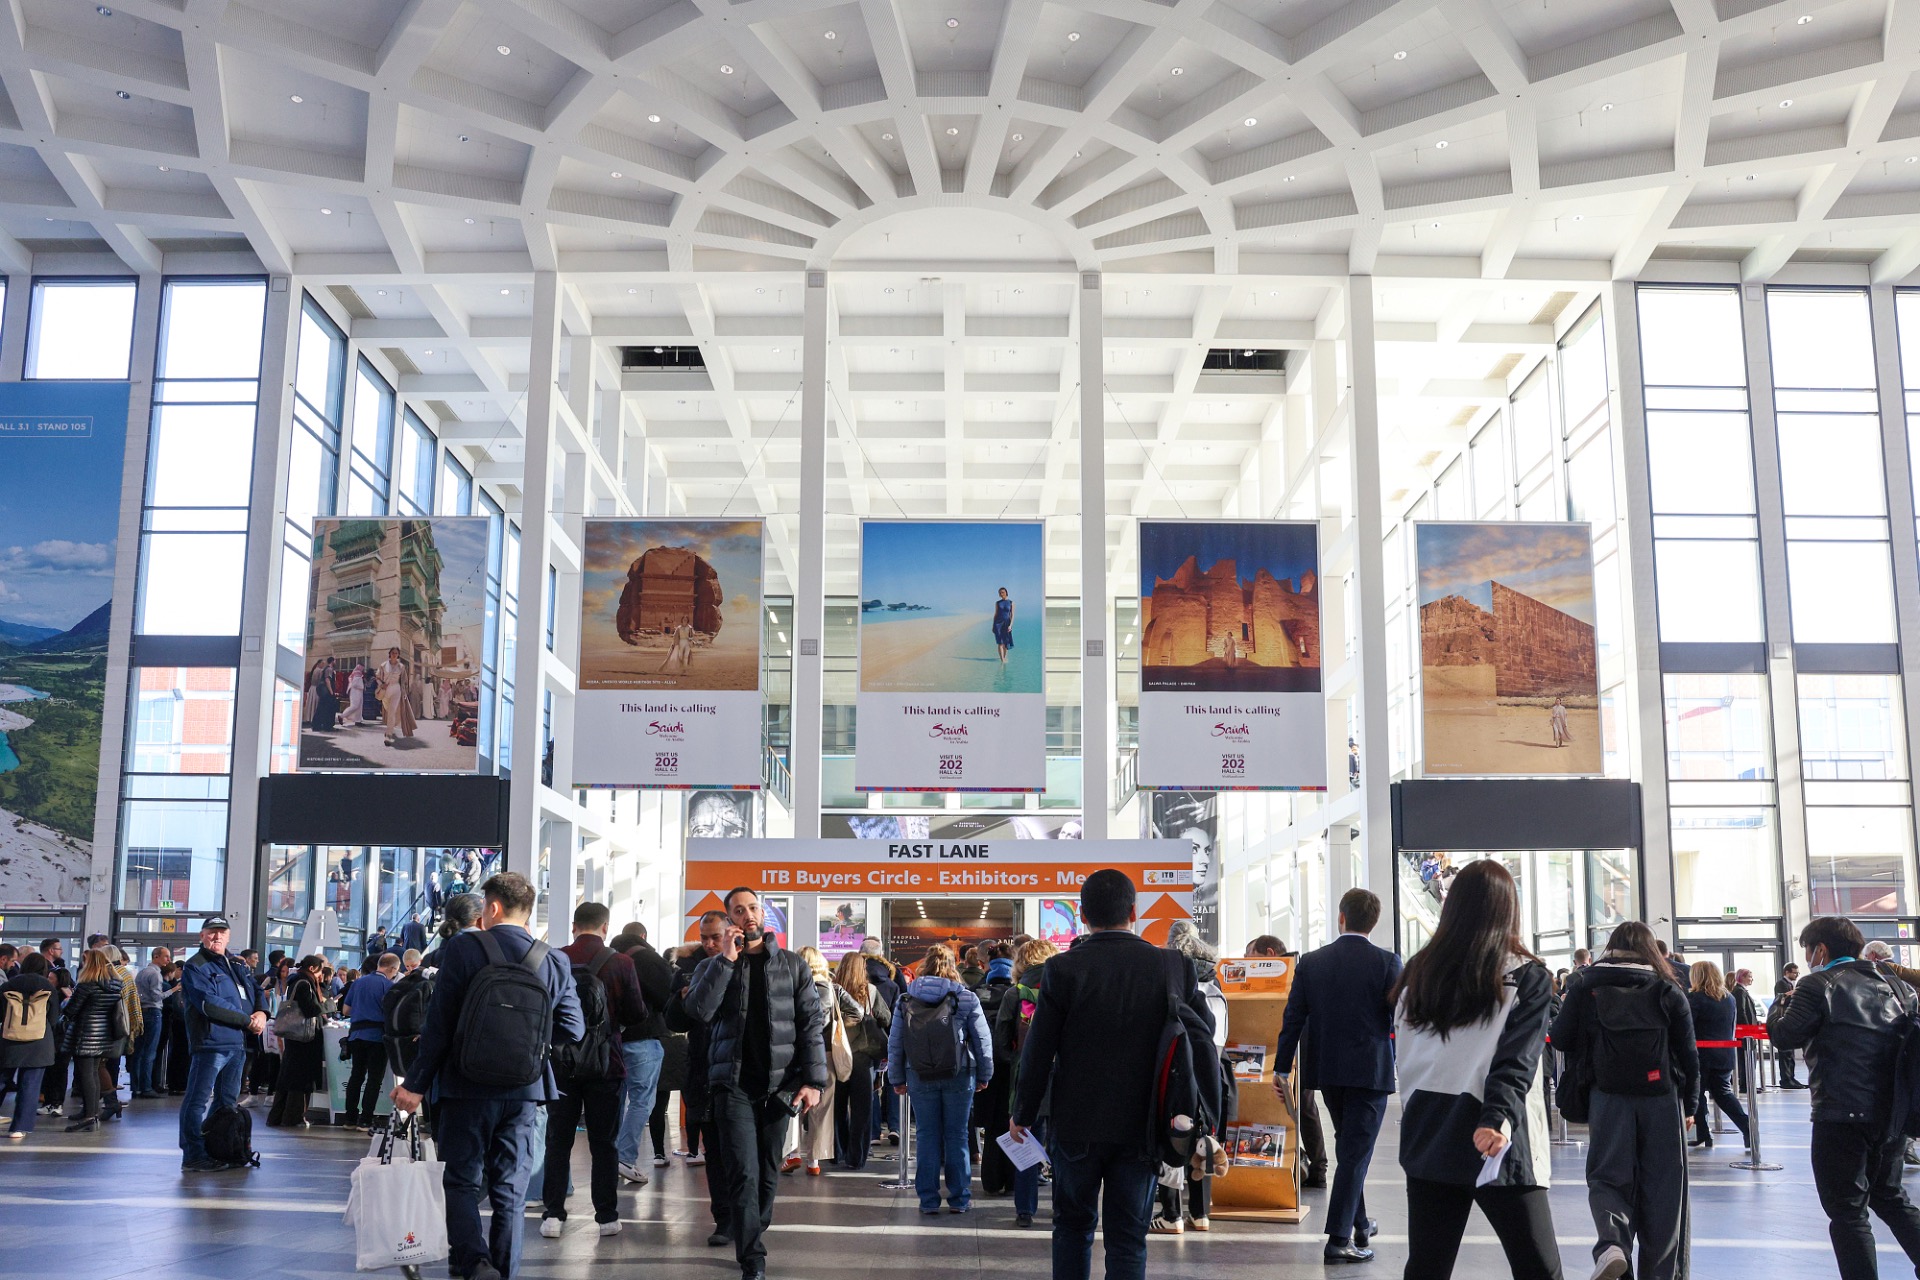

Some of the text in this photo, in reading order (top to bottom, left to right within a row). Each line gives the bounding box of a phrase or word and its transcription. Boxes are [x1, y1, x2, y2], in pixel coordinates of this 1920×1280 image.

[620, 703, 716, 715] This land is calling
[902, 706, 1000, 717] This land is calling
[1184, 705, 1281, 716] This land is calling
[655, 757, 678, 766] 202
[940, 760, 962, 769] 202
[1222, 759, 1244, 768] 202
[889, 844, 989, 858] FAST LANE
[761, 870, 790, 884] ITB
[796, 870, 861, 888] Buyers
[867, 870, 921, 885] Circle
[939, 870, 1038, 885] Exhibitors
